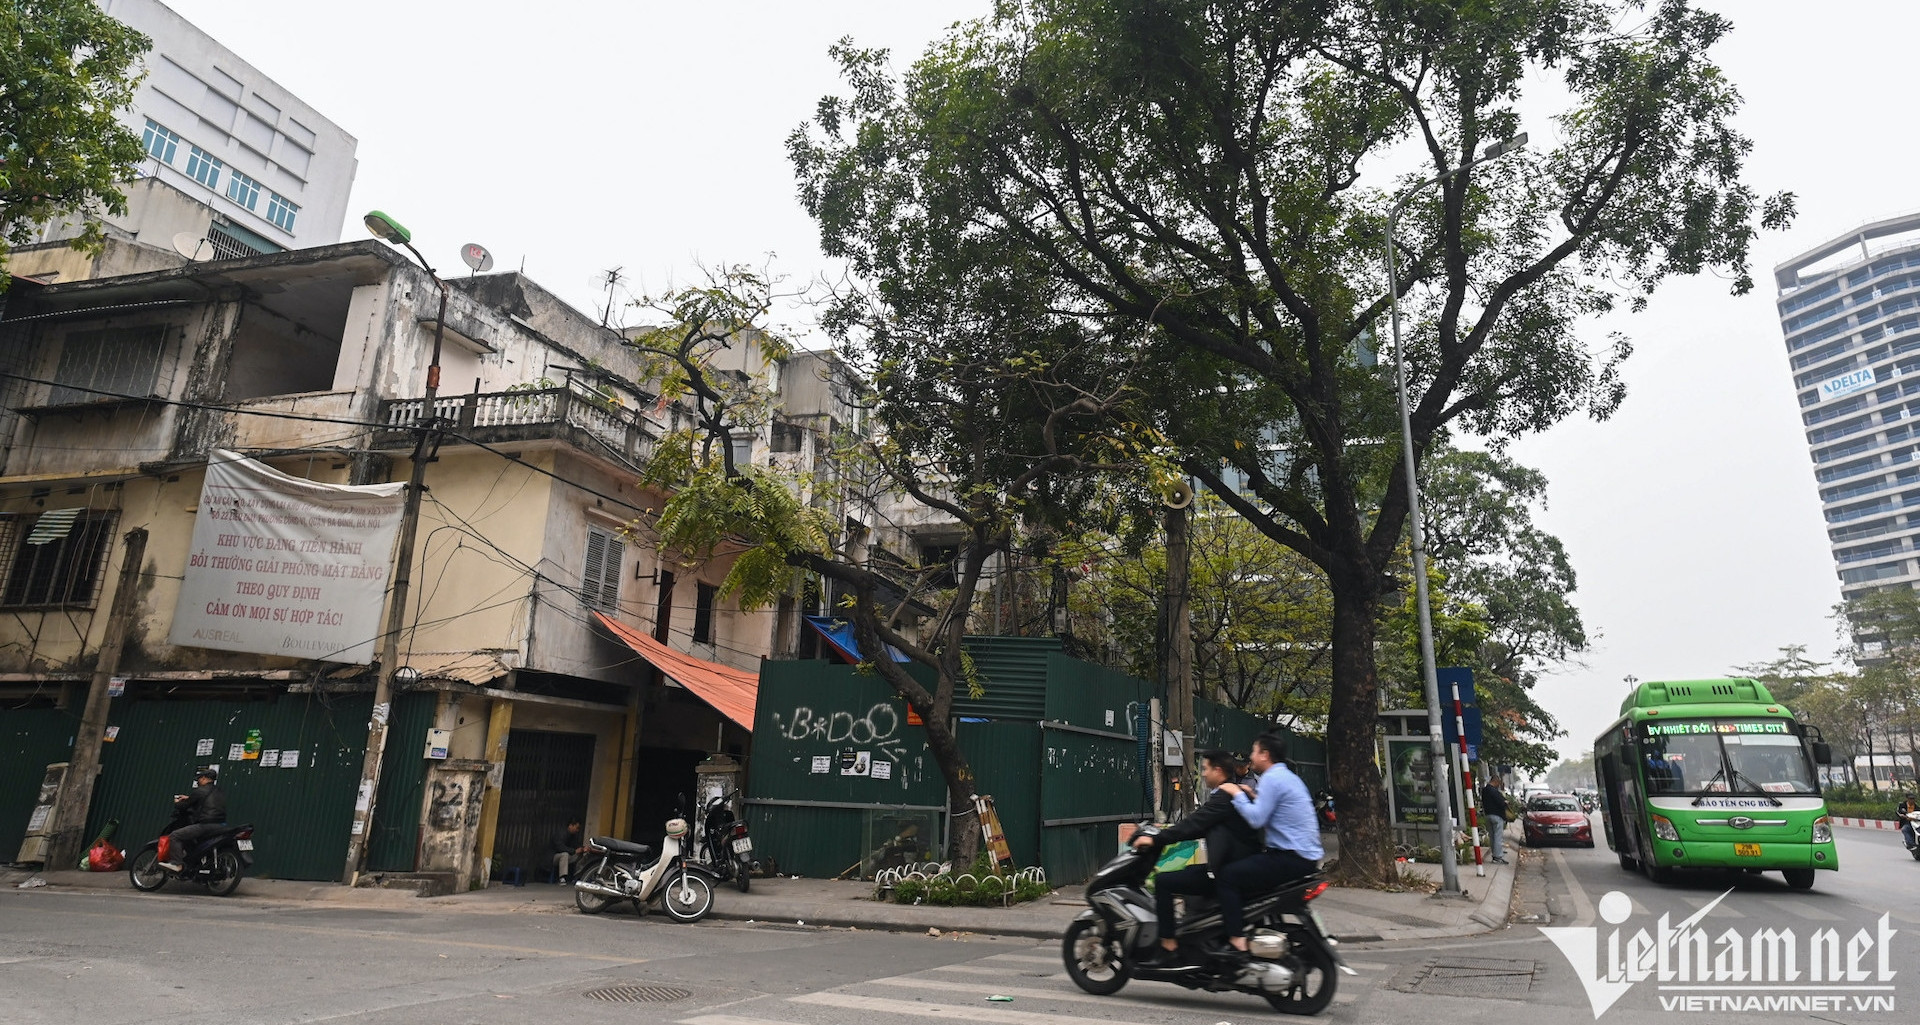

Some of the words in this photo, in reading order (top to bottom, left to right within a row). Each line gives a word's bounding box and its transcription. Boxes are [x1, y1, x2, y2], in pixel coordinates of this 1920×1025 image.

[1831, 369, 1872, 391] DELTA
[221, 511, 229, 520] 22
[217, 534, 240, 547] KHU
[242, 535, 264, 552] VỰC
[265, 538, 295, 552] ĐANG
[300, 535, 328, 553] TIẾN
[328, 538, 363, 555] HÀNH
[211, 555, 253, 572] THƯỜNG
[255, 556, 280, 573] GIẢI
[322, 561, 349, 580] MẶT
[236, 582, 265, 596] THEO
[266, 584, 291, 600] QUY
[292, 586, 321, 602] ĐỊNH
[206, 597, 230, 616] CẢM
[232, 603, 247, 618] ƠN
[248, 606, 271, 622] MỌI
[273, 608, 289, 624] SỰ
[290, 609, 314, 626] HỢP
[316, 608, 344, 626] TÁC!
[193, 629, 244, 644] AUSREAL
[1647, 725, 1661, 736] BV
[1692, 722, 1710, 734] ĐỚI
[1734, 723, 1764, 733] TIMES
[1766, 722, 1787, 733] CITY
